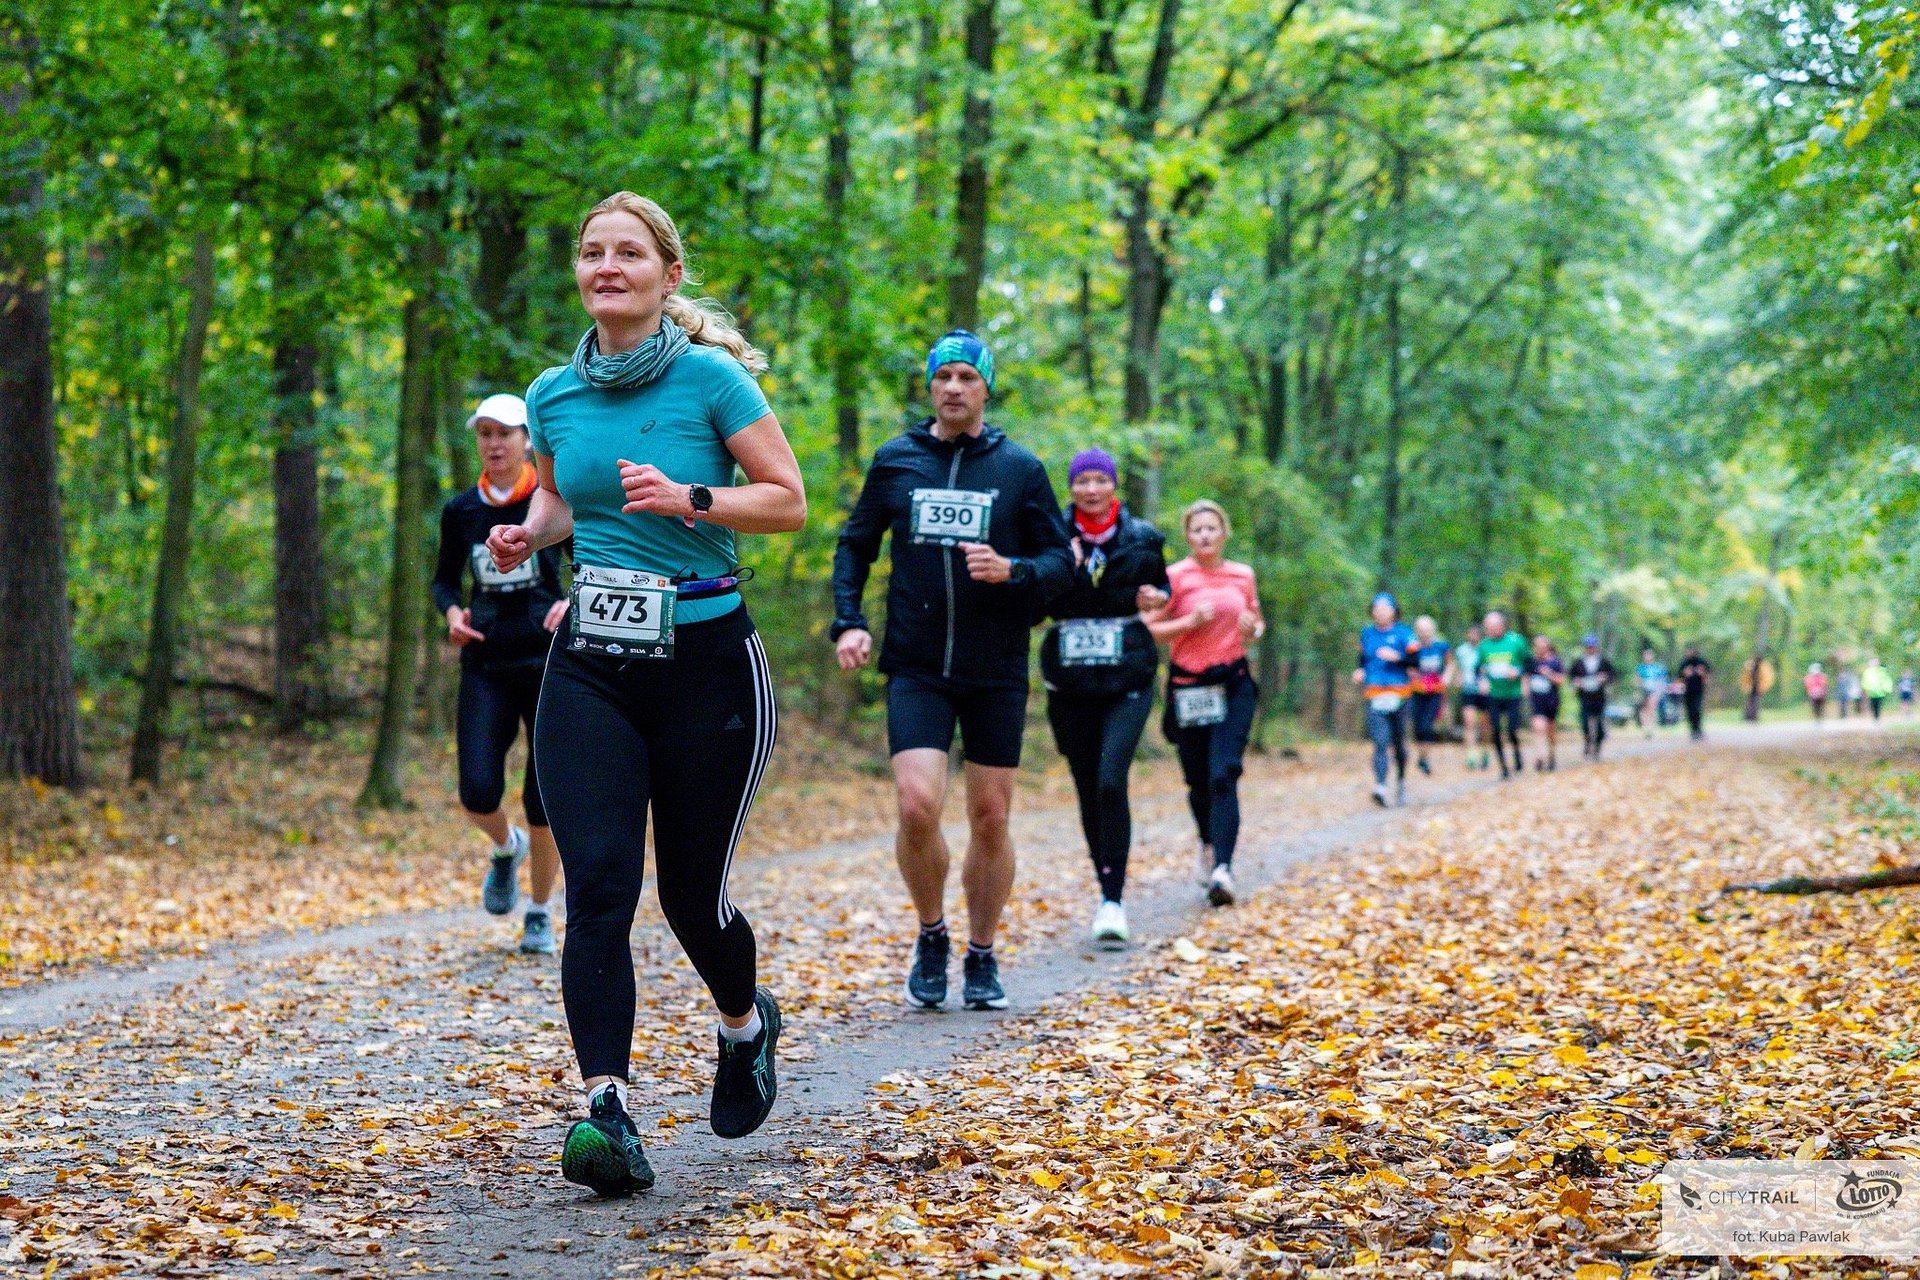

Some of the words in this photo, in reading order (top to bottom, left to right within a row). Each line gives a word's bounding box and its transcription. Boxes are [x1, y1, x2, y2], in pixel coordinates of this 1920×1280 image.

[928, 506, 973, 526] 390
[589, 592, 648, 624] 473
[1075, 634, 1106, 649] 235
